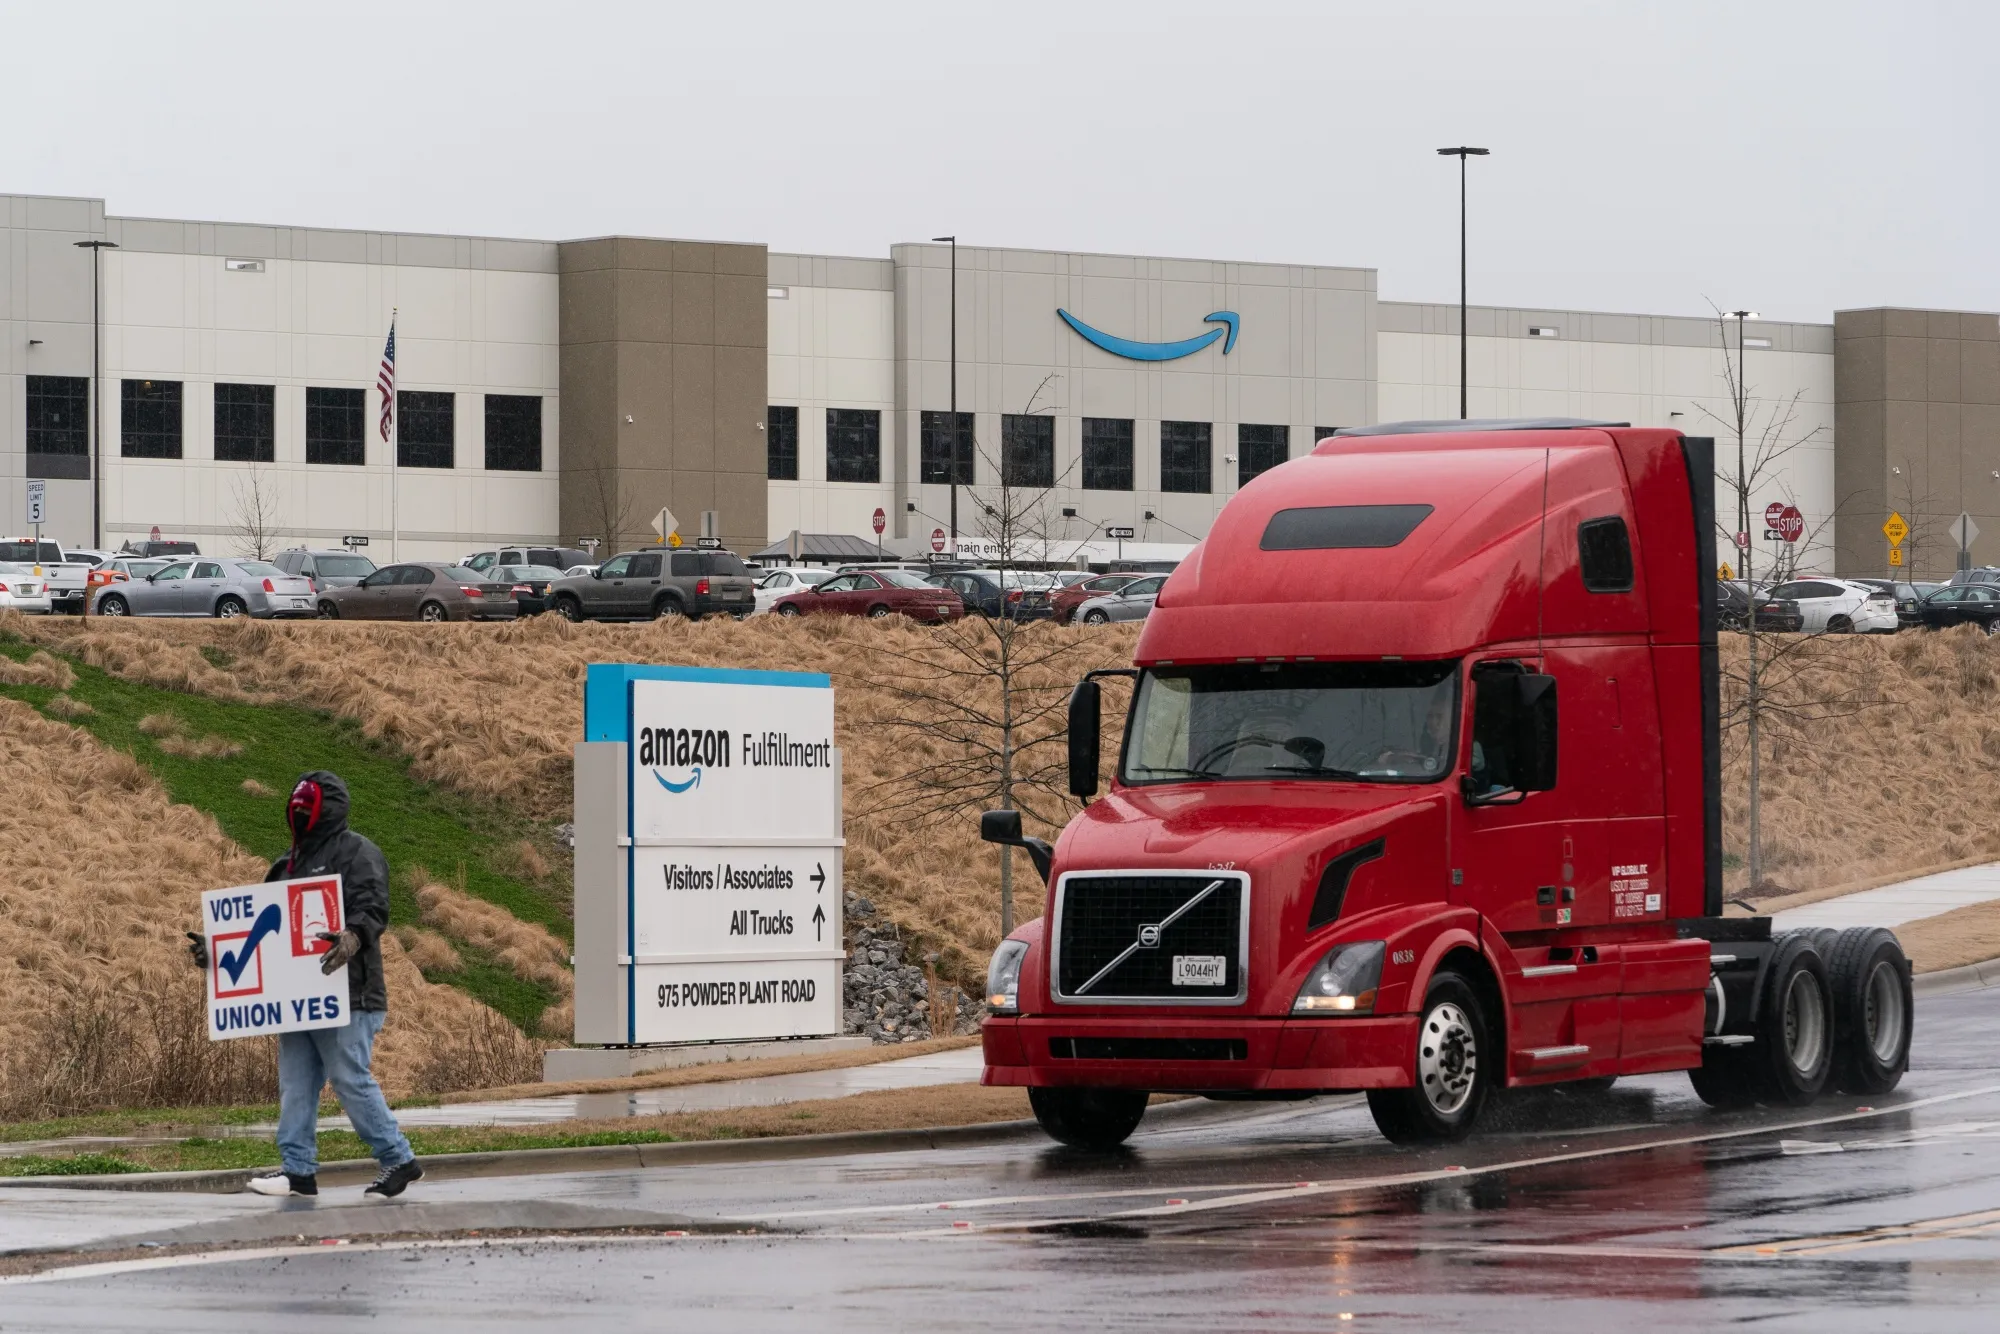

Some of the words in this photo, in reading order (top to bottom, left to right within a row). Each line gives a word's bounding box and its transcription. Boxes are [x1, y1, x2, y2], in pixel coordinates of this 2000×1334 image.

[33, 504, 40, 519] 5
[873, 516, 885, 526] STOP
[1780, 518, 1802, 532] STOP
[1740, 534, 1745, 544] 1
[1894, 550, 1898, 560] 5
[639, 727, 730, 768] amazon
[743, 732, 830, 768] Fulfillment
[664, 864, 714, 890] Visitors
[724, 864, 794, 890] Associates
[210, 895, 254, 922] VOTE
[730, 910, 748, 936] All
[750, 910, 794, 935] Trucks
[1393, 950, 1414, 964] 0838
[1180, 964, 1219, 977] L9044HY
[658, 984, 679, 1008] 975
[682, 982, 736, 1006] POWDER
[740, 980, 779, 1004] PLANT
[782, 980, 815, 1002] ROAD
[216, 1001, 282, 1031] UNION
[292, 995, 340, 1022] YES
